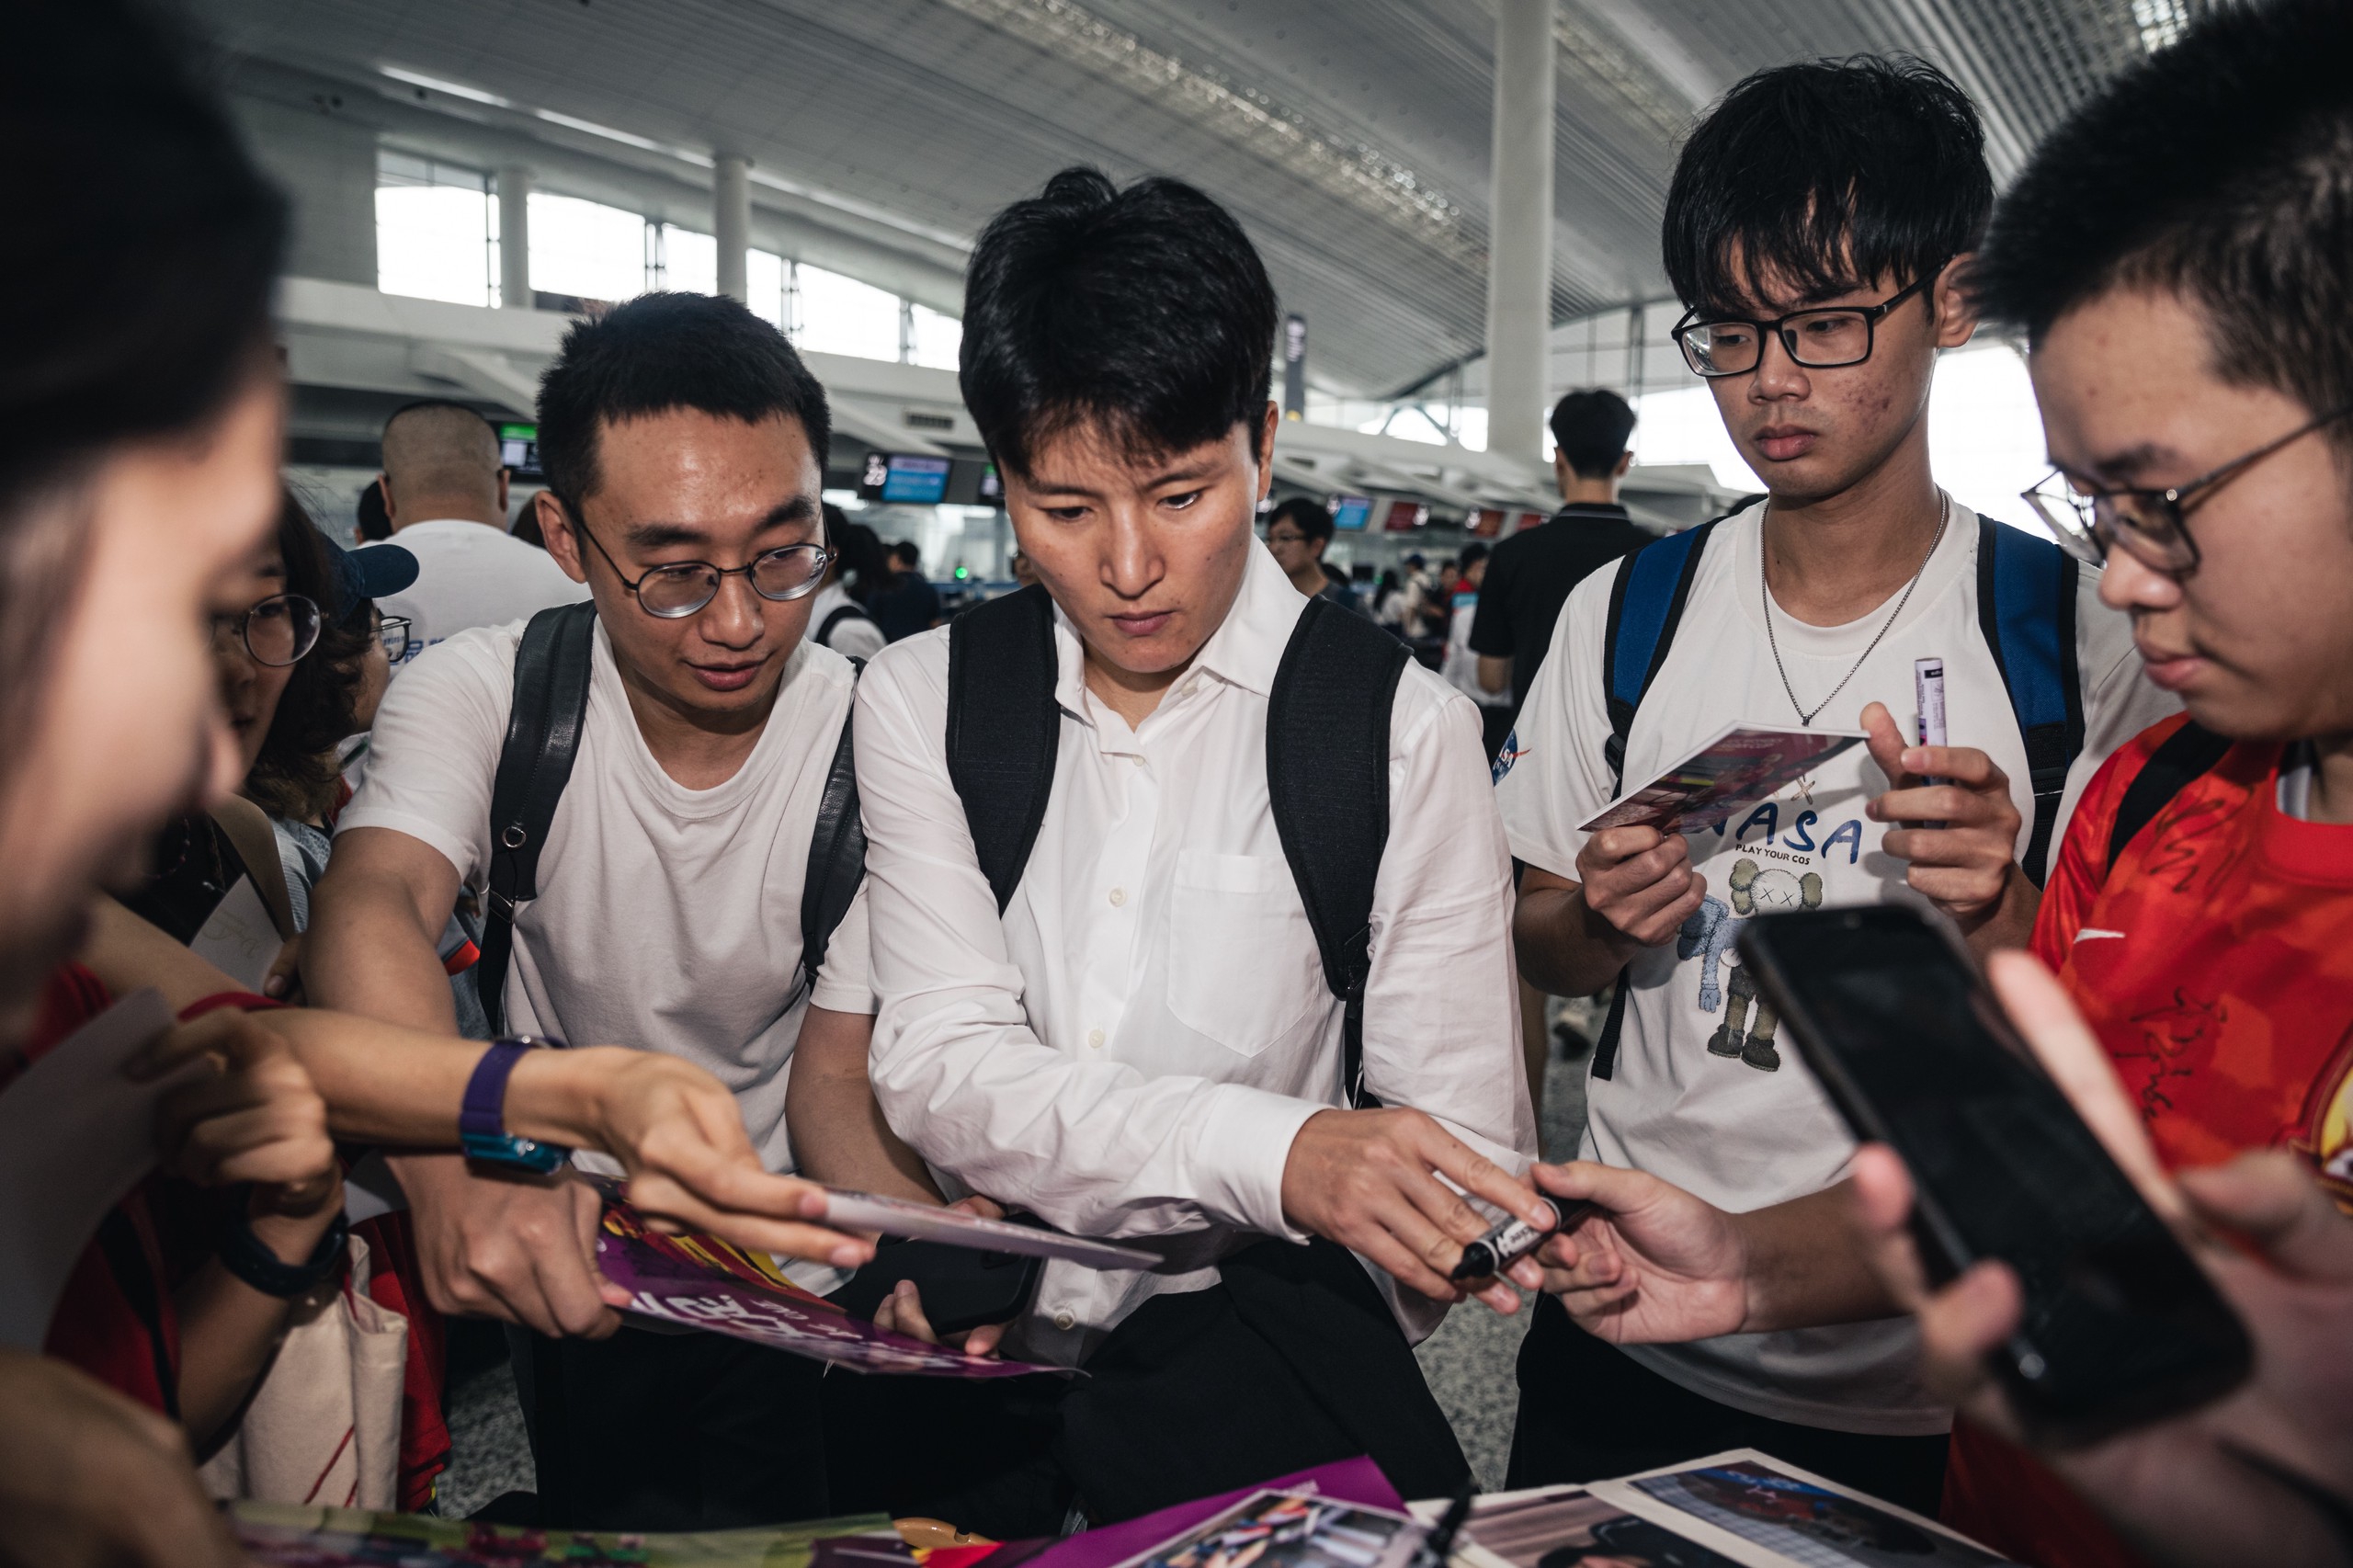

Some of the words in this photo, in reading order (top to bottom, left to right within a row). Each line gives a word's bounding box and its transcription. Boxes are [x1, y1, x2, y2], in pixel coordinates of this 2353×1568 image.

[1712, 802, 1862, 864] ASA
[1735, 844, 1762, 855] PLAY
[1764, 848, 1790, 861] YOUR
[1791, 855, 1811, 865] COS
